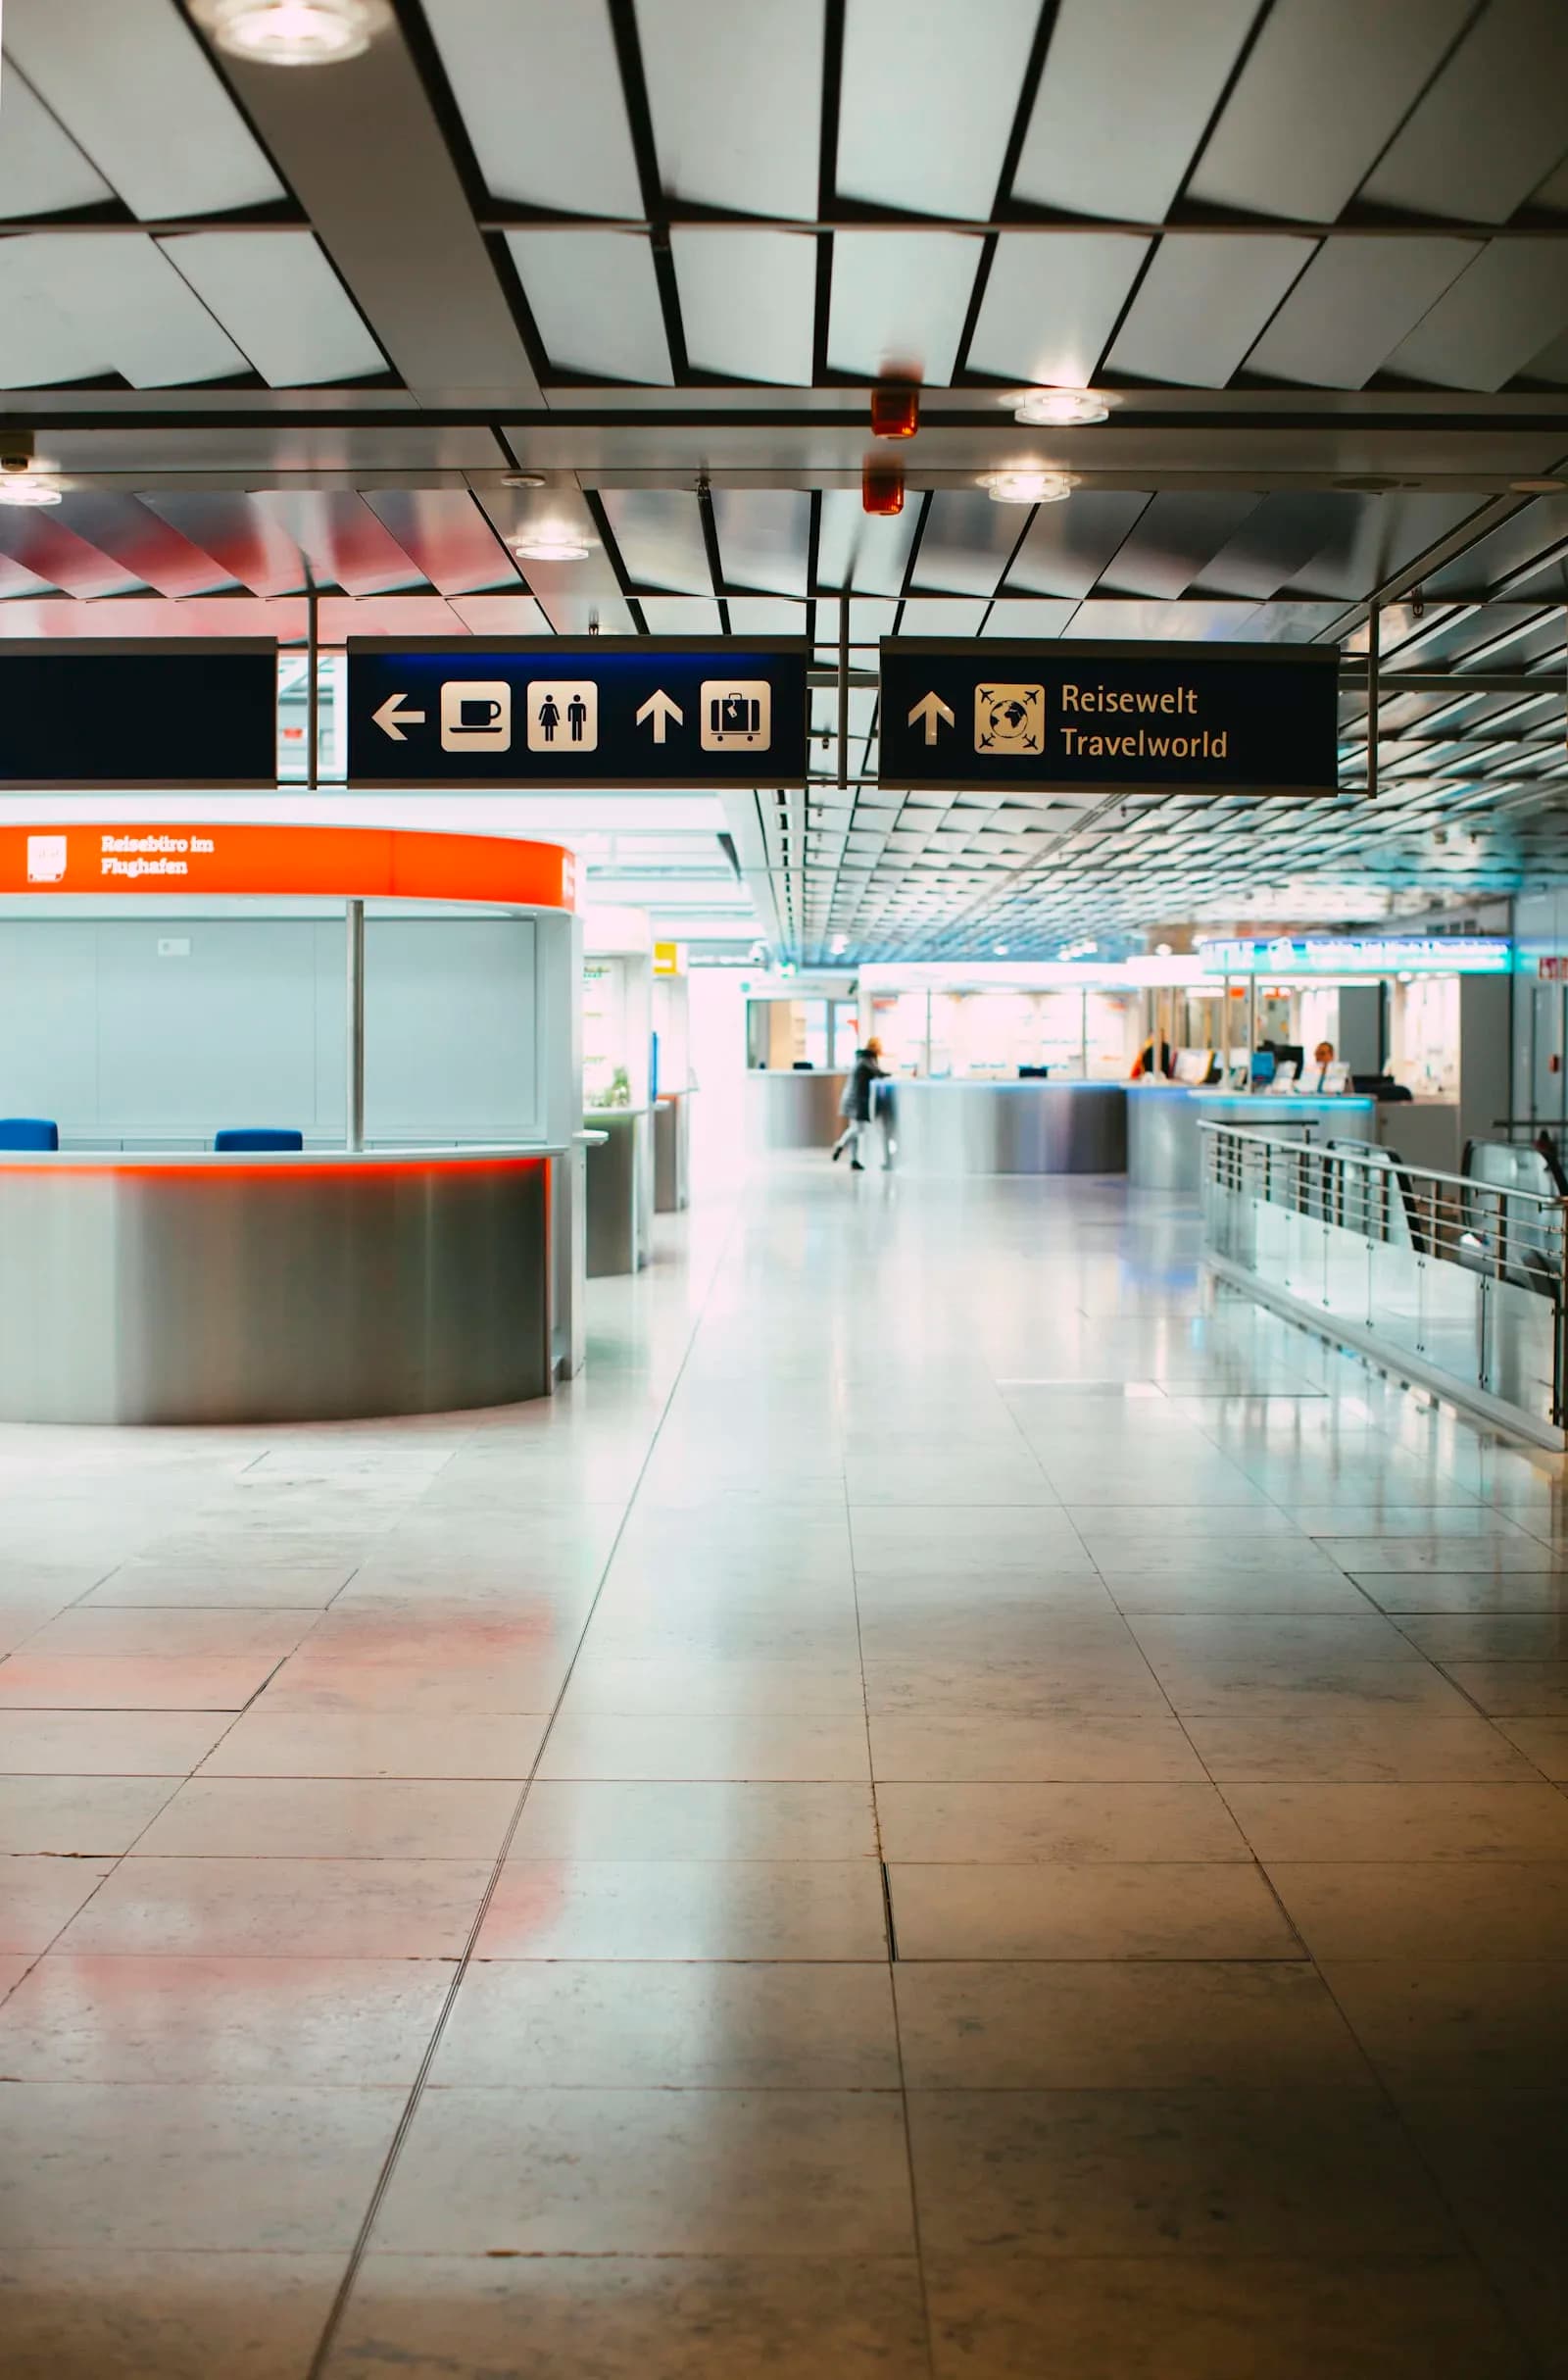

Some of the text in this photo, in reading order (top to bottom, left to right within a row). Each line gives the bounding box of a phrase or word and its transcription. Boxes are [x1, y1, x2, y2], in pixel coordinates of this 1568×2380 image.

[1061, 684, 1198, 714] Reisewelt
[1059, 727, 1227, 758] Travelworld
[101, 835, 215, 853] Reisebüro im
[101, 858, 188, 878] Flughafen
